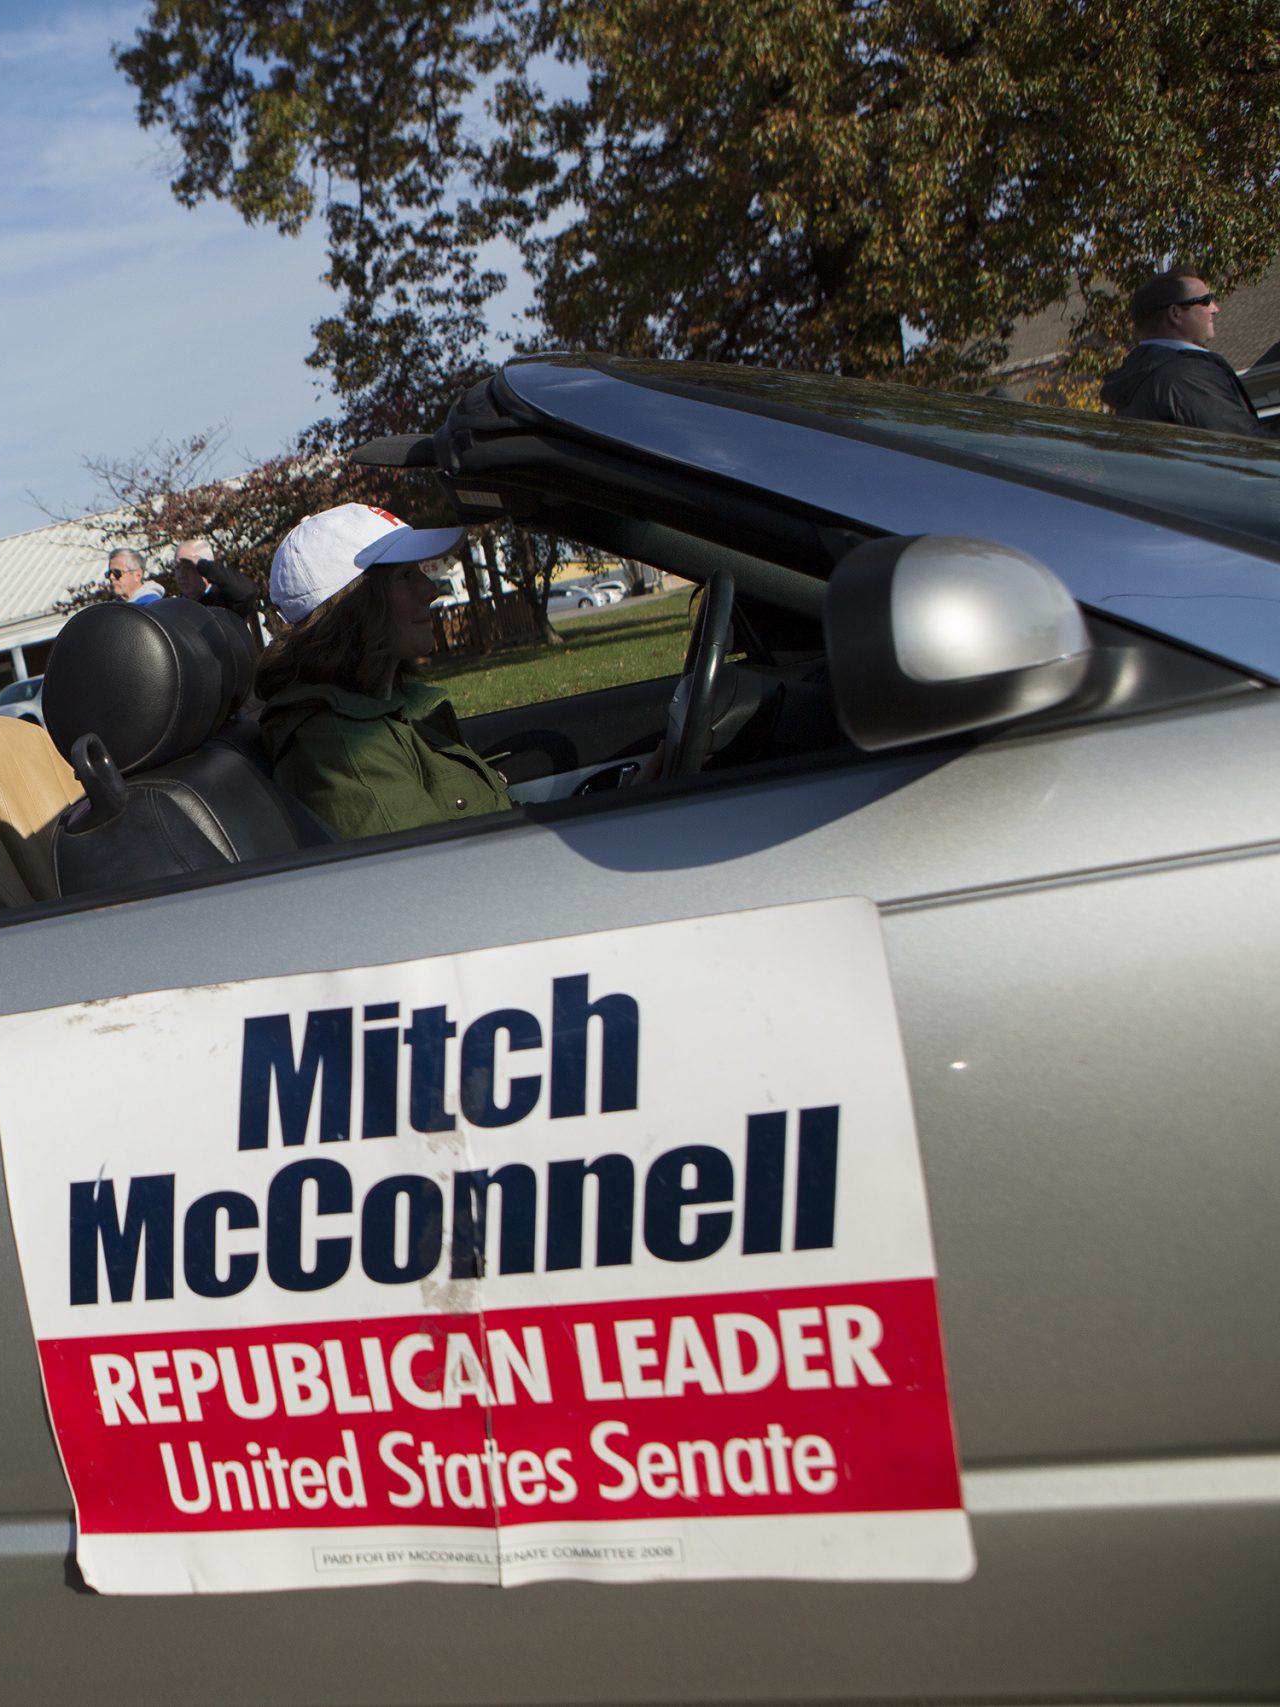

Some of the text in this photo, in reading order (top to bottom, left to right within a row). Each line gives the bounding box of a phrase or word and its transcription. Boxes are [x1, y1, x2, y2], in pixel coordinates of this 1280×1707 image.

[239, 974, 639, 1151] Mitch
[70, 1106, 840, 1305] McConnell
[91, 1305, 891, 1425] REPUBLICAN LEADER
[160, 1421, 836, 1514] United States Senate
[322, 1552, 353, 1566] PAID
[356, 1552, 384, 1565] FOR
[386, 1550, 405, 1562] BY
[496, 1547, 548, 1564] SENATE
[551, 1546, 636, 1559] COMMITTEE
